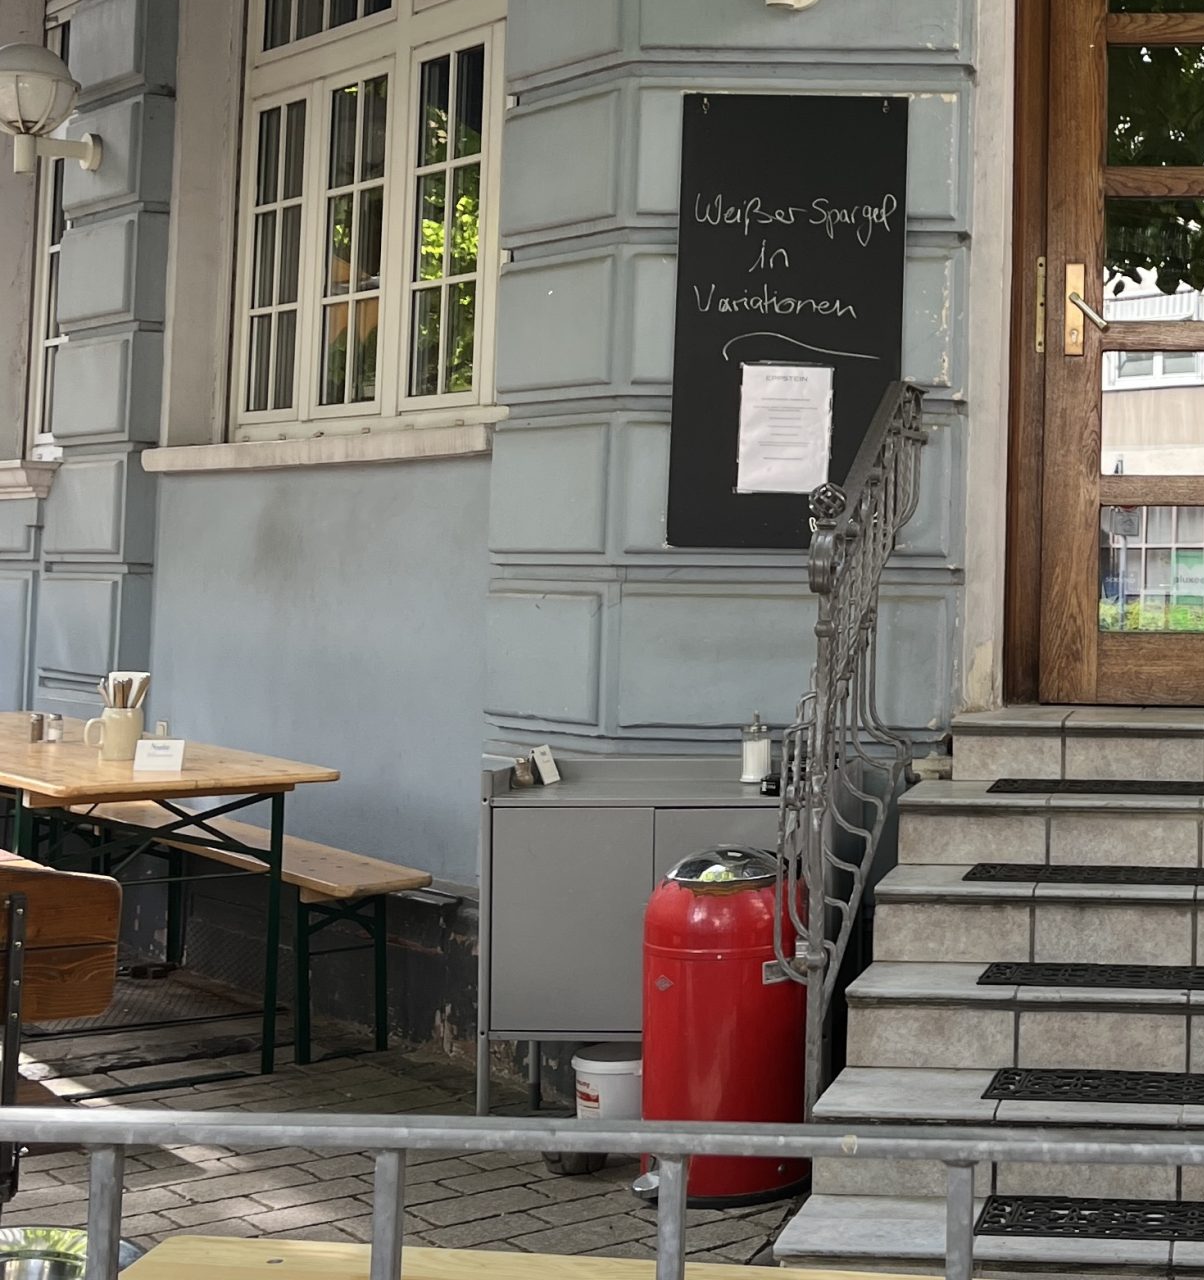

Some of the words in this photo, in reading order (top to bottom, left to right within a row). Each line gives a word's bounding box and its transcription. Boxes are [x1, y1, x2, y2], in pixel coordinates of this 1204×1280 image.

[695, 193, 805, 235] Weißer
[808, 193, 897, 247] Spargel
[749, 239, 789, 273] in
[693, 283, 857, 319] Variationen
